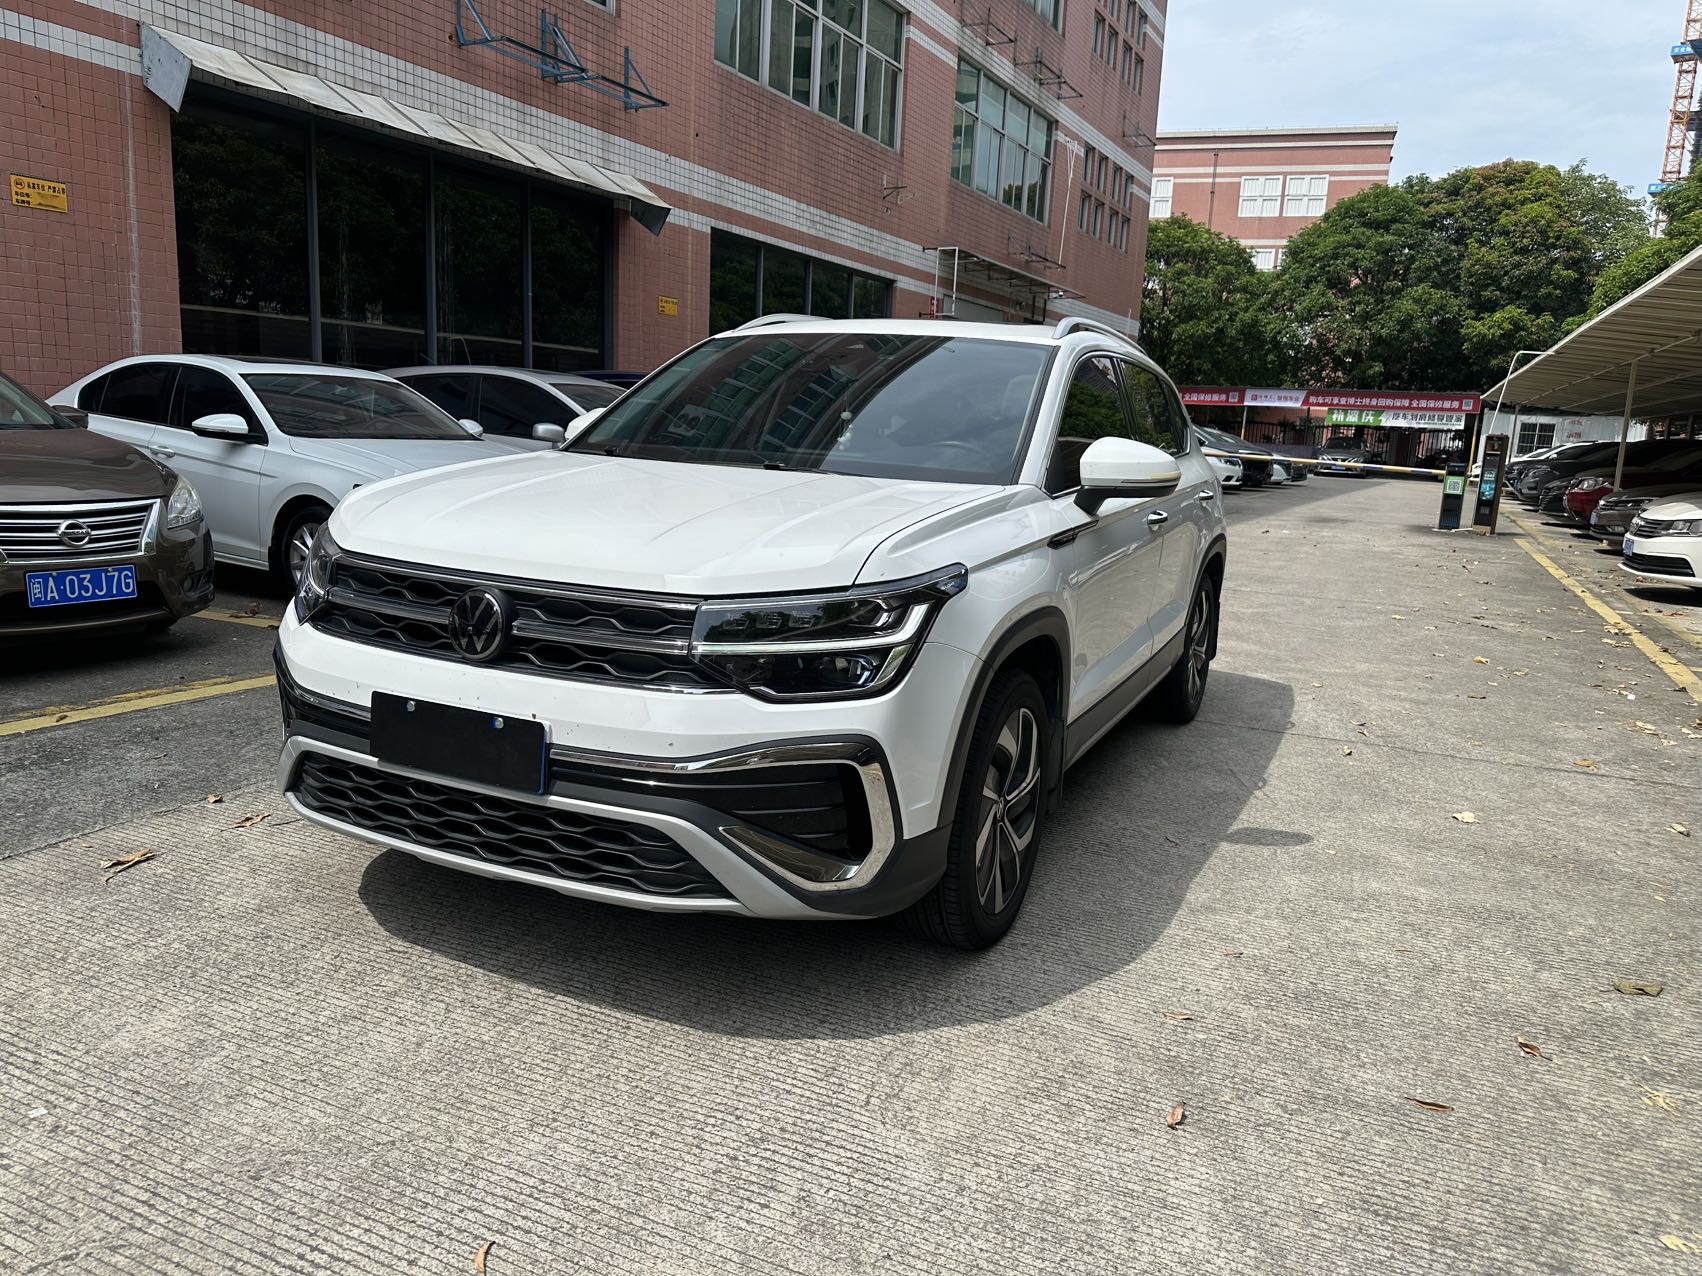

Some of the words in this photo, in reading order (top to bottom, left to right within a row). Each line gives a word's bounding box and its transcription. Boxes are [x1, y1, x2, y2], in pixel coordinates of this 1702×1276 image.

[1411, 399, 1460, 409] 全国保修服务
